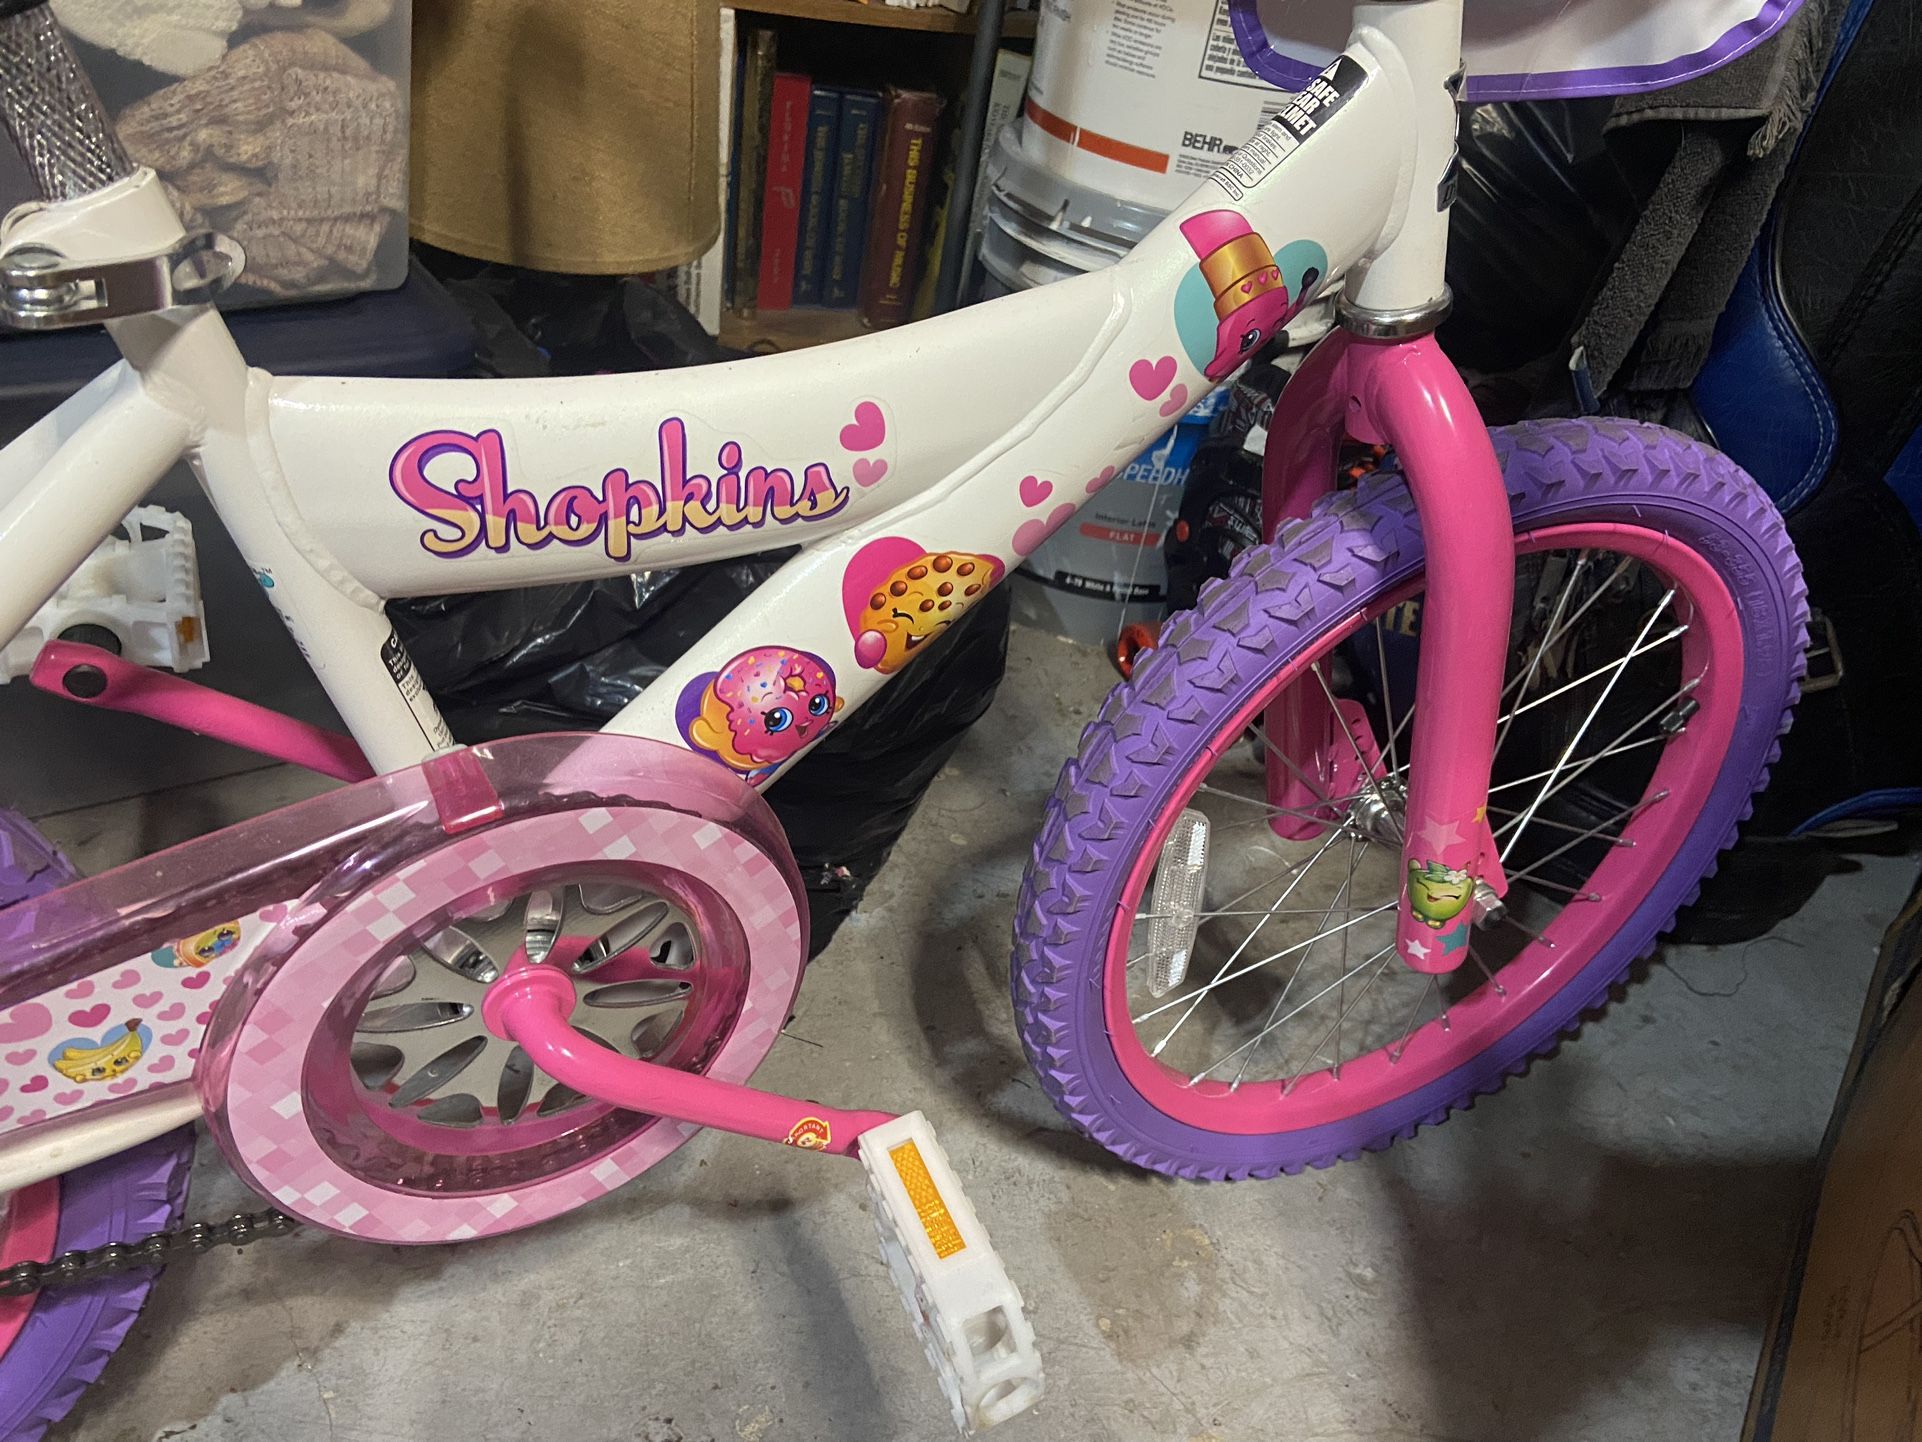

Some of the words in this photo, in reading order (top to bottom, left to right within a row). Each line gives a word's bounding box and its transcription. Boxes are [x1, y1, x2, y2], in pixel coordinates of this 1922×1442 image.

[1306, 78, 1340, 107] SAFE
[907, 138, 922, 167] THIS
[1182, 131, 1223, 153] BEHR
[1228, 163, 1244, 178] CHINA
[1240, 153, 1263, 174] Questions
[898, 169, 918, 230] BUSINESS
[389, 417, 849, 561] Shopkins
[1109, 531, 1135, 541] FLAT
